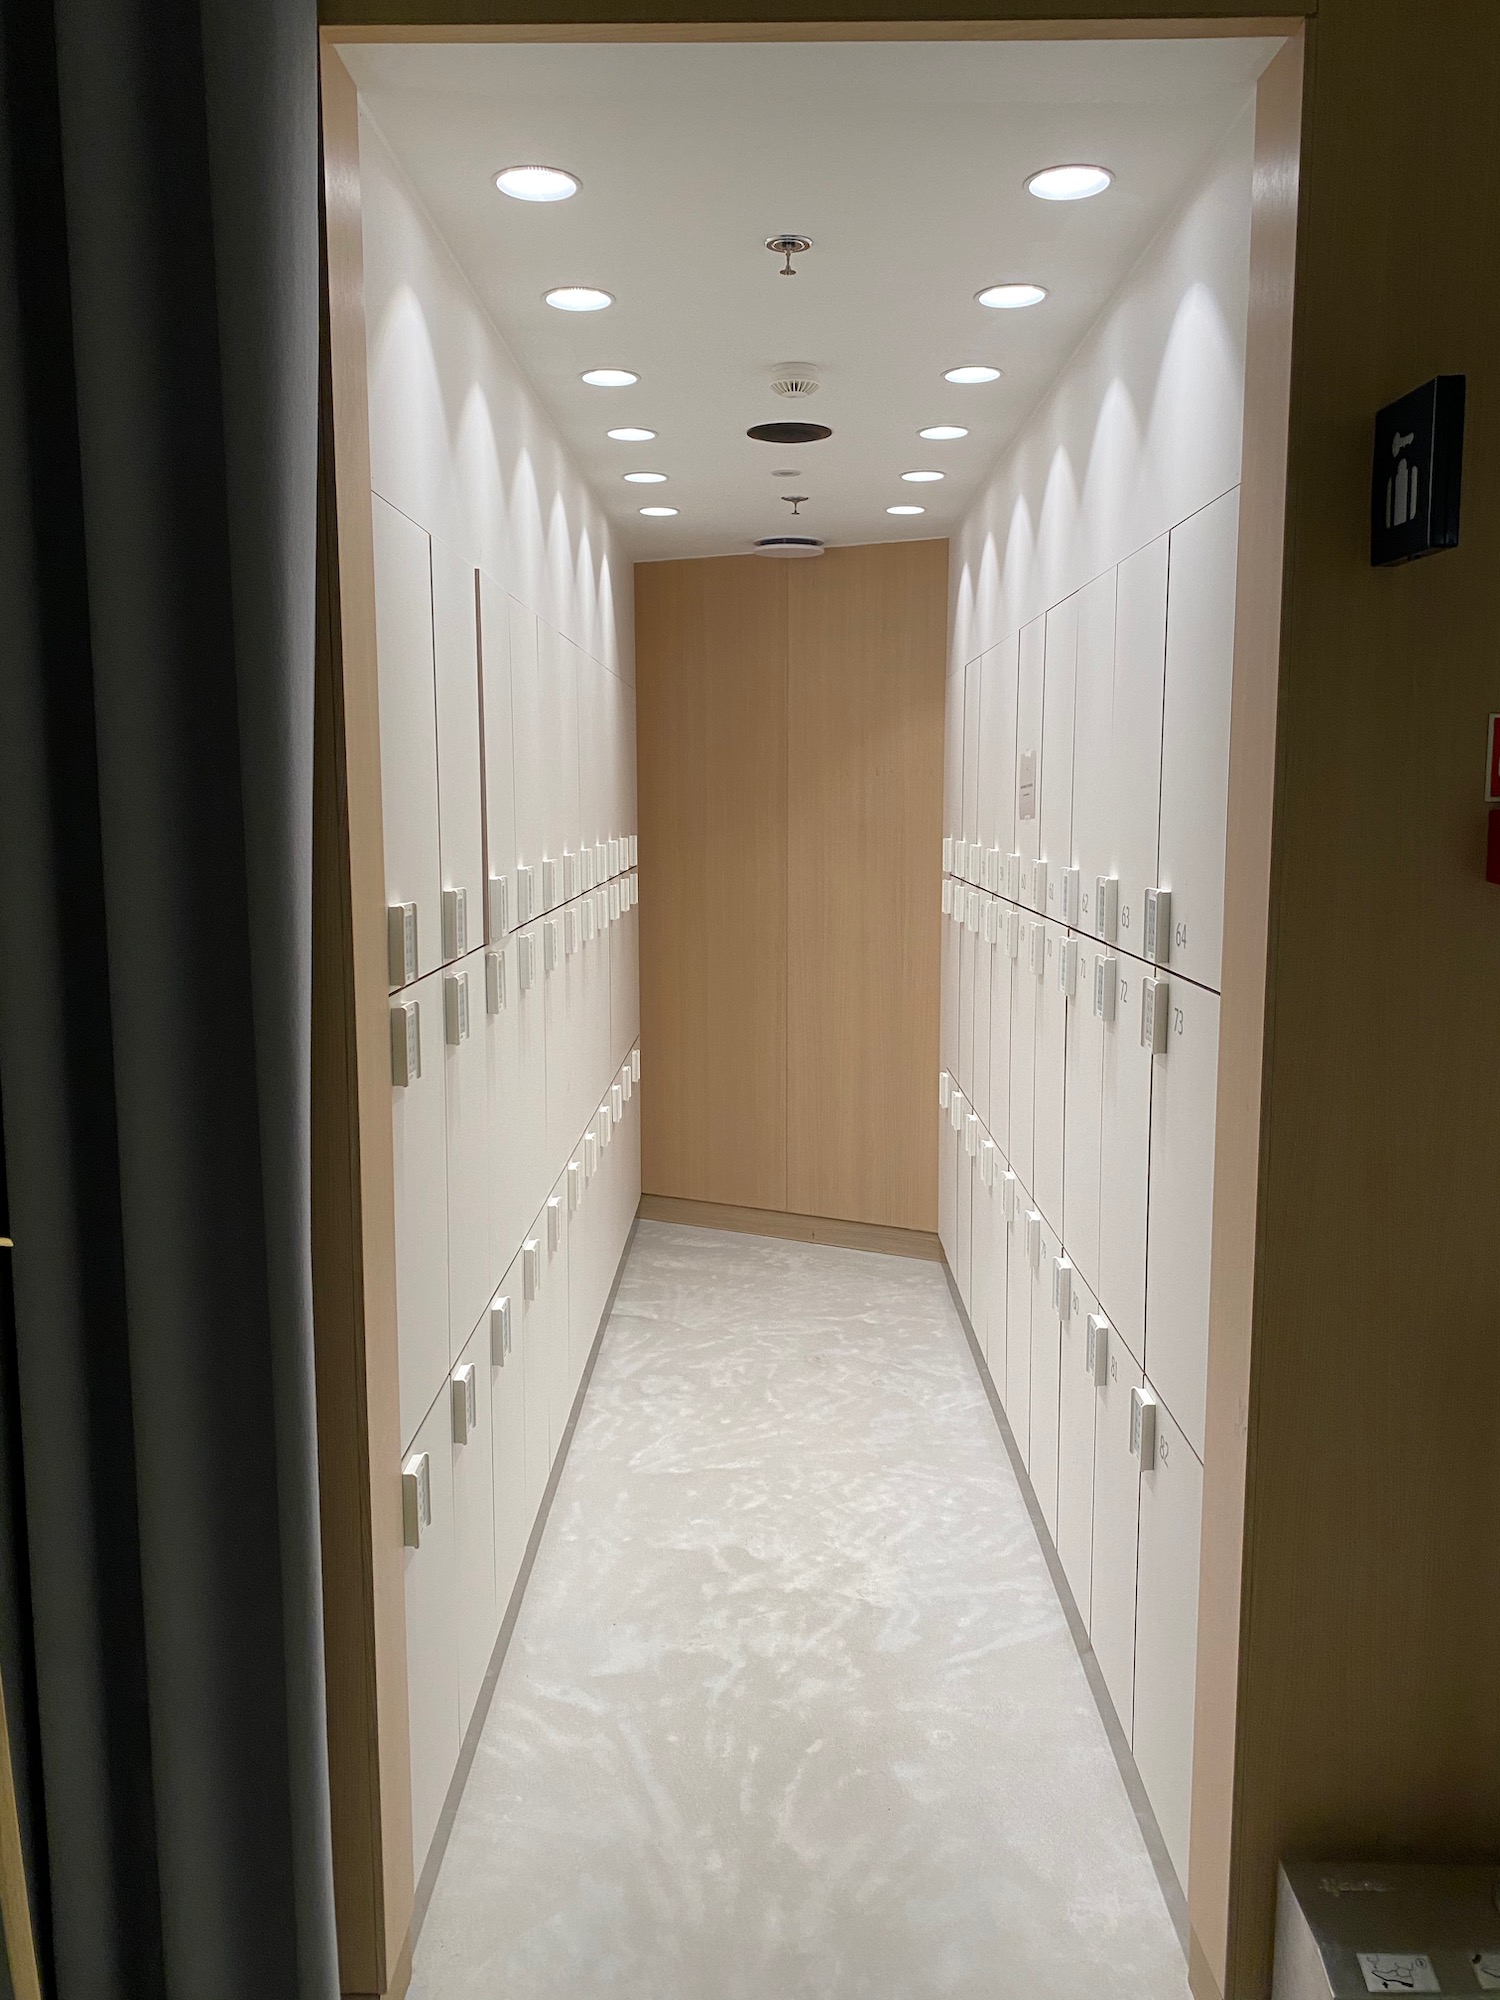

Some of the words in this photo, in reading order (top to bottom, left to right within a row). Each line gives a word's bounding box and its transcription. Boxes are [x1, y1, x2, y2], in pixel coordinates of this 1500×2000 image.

[1082, 893, 1089, 913] 62
[1121, 905, 1130, 928] 63
[1176, 923, 1187, 949] 64
[1120, 980, 1128, 1003] 72
[1174, 1008, 1184, 1035] 73
[1159, 1434, 1169, 1467] 82
